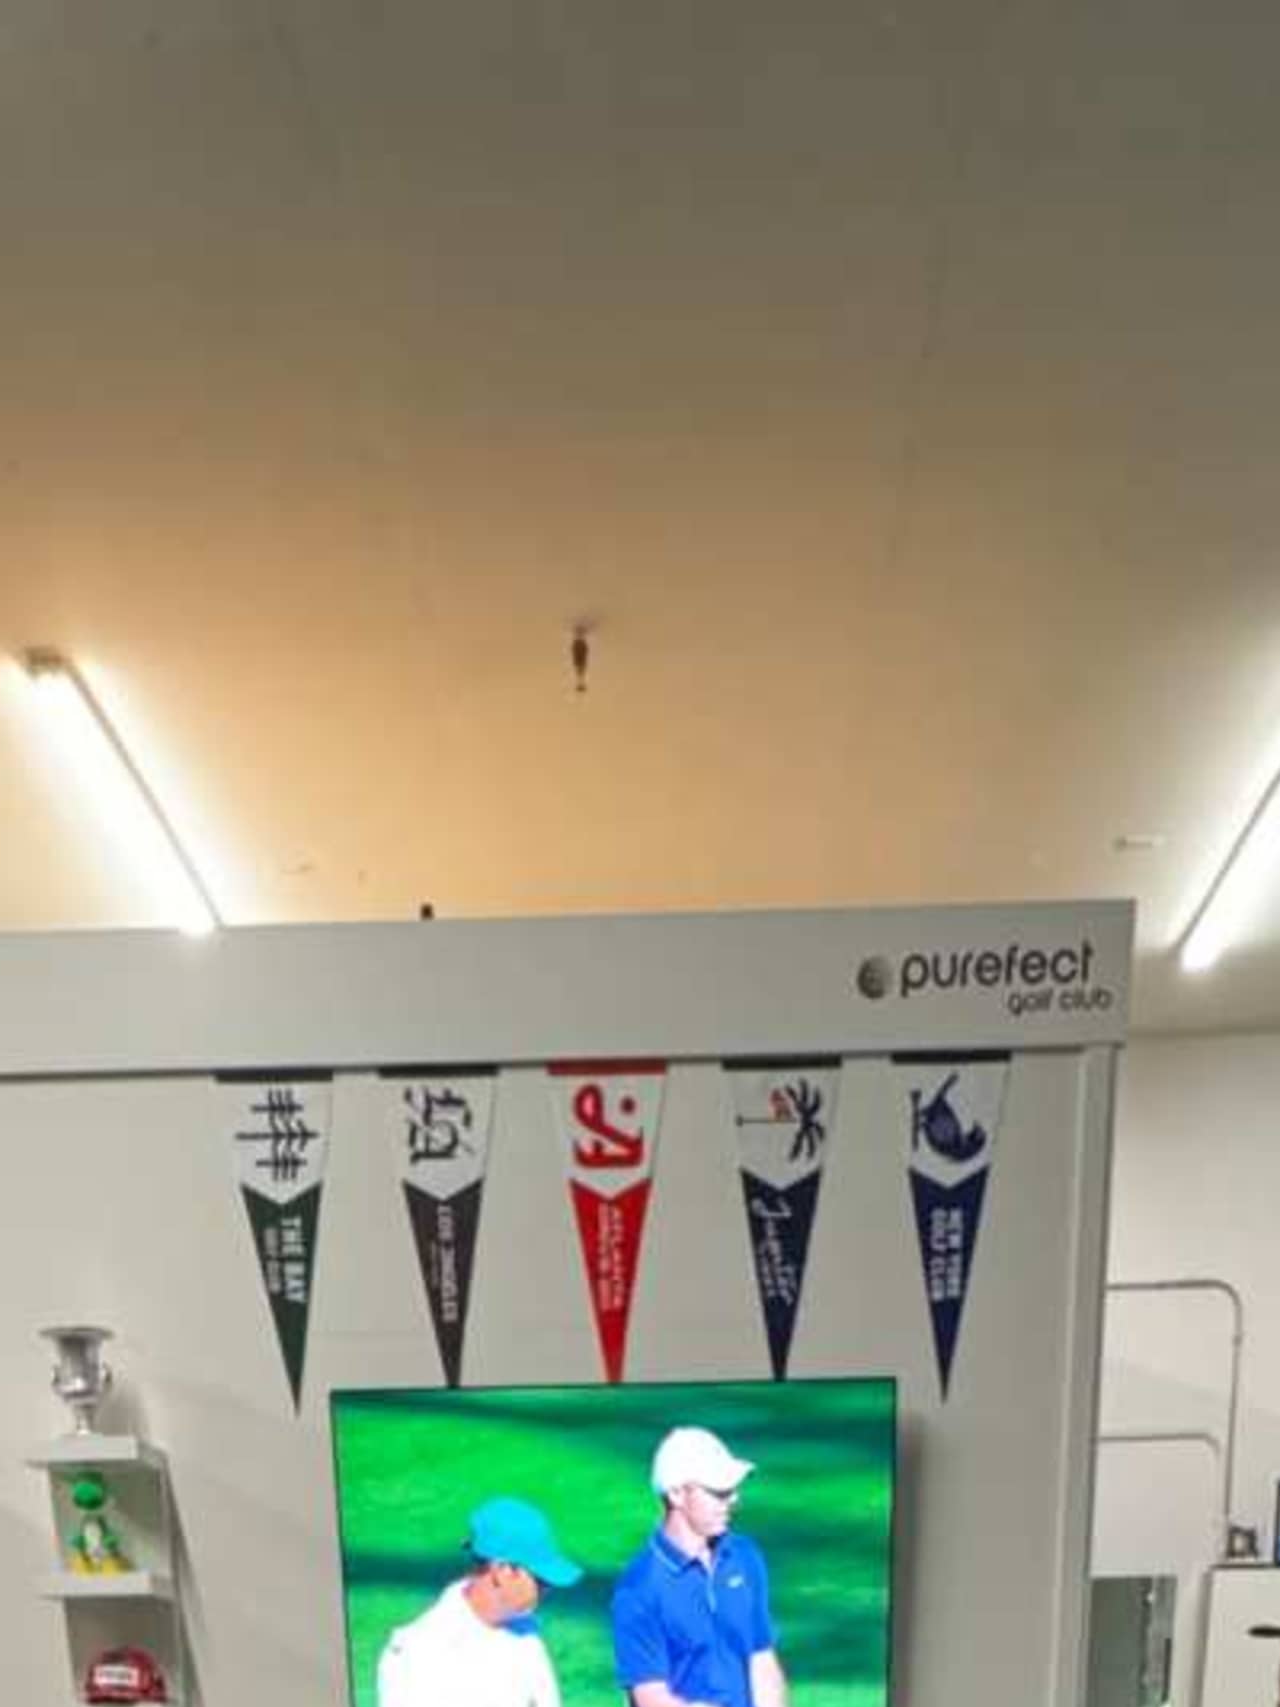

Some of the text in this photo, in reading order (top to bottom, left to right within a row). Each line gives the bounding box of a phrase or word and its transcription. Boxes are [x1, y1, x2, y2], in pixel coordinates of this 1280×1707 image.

[900, 939, 1095, 998] purefect
[1007, 988, 1112, 1016] golf club
[281, 1216, 306, 1302] THE BAY
